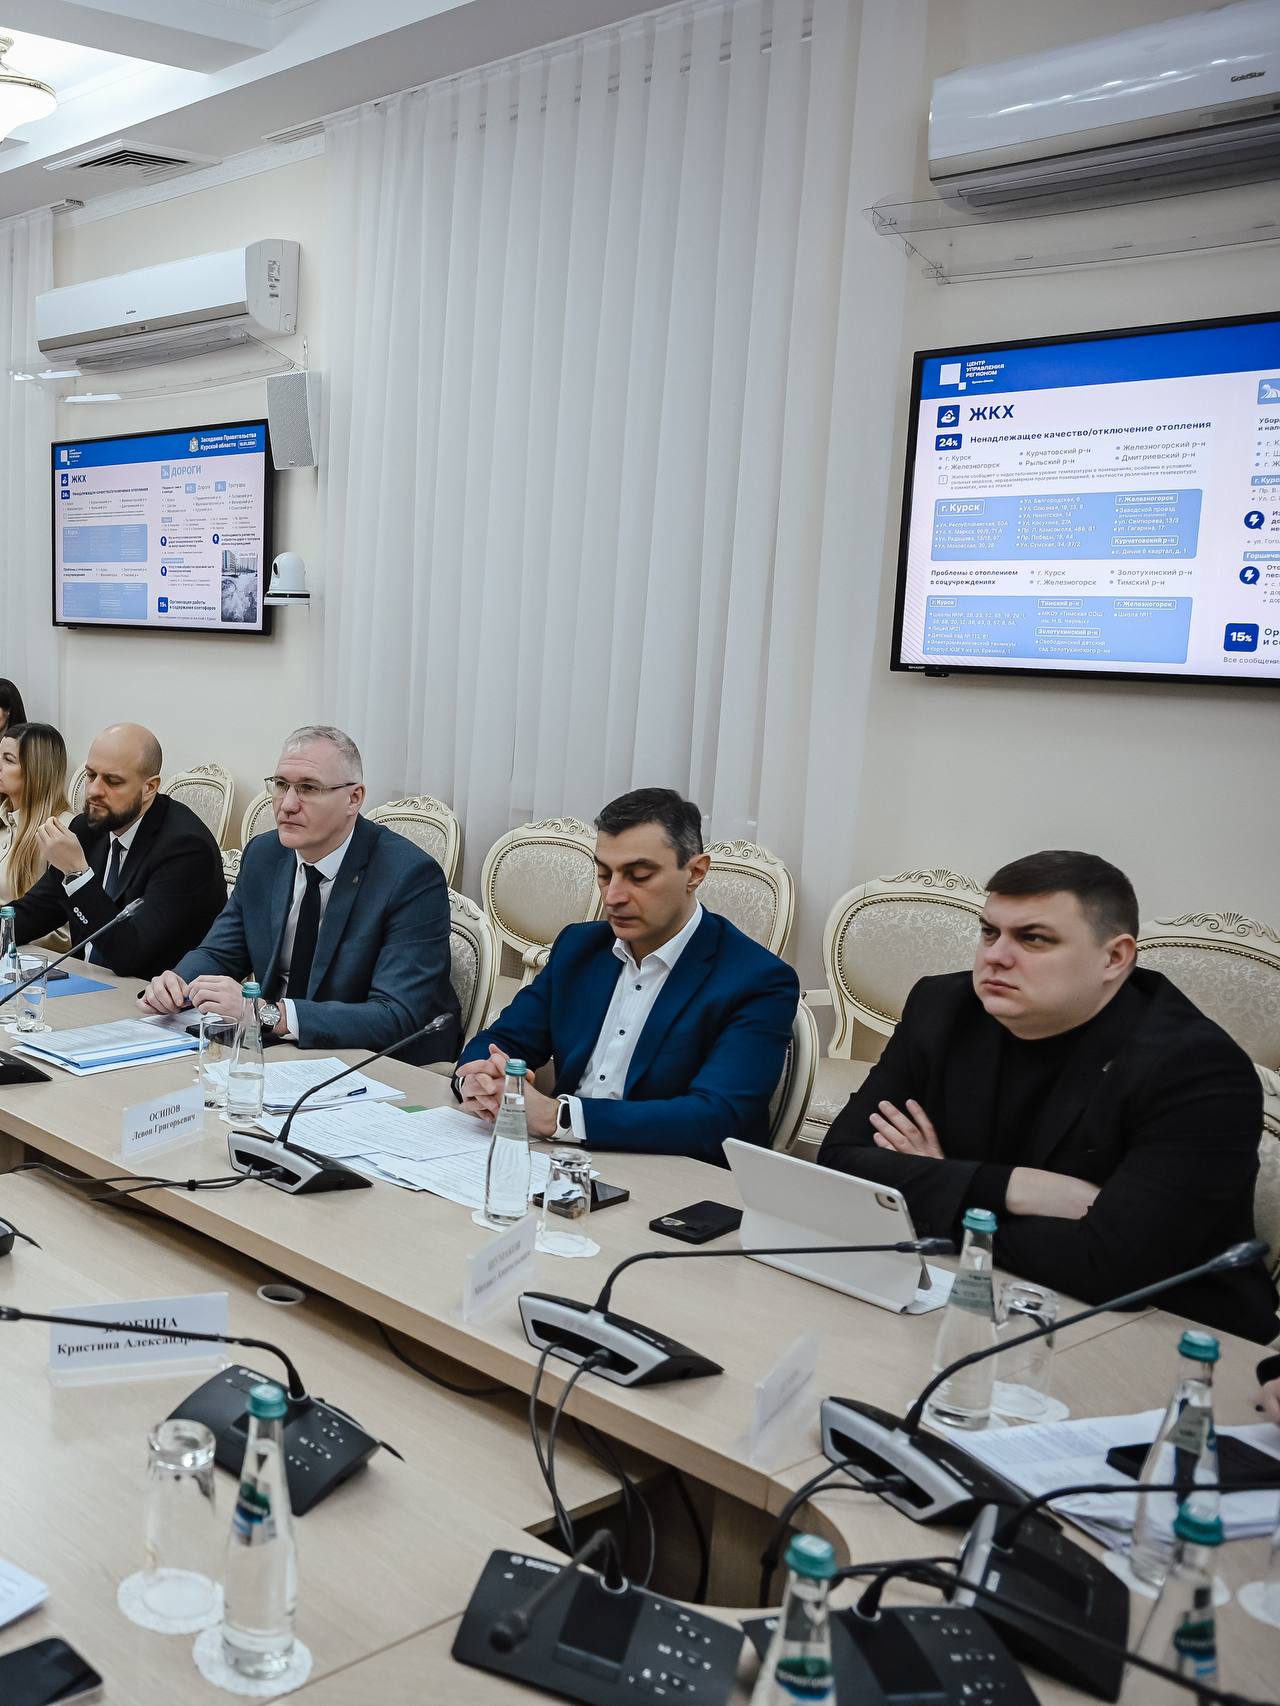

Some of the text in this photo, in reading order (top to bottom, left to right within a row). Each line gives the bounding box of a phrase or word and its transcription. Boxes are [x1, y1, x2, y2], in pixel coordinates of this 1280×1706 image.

[1230, 70, 1266, 83] GoldStar
[966, 363, 1005, 373] УПРАВЛЕНИЯ
[965, 370, 998, 378] РЕГИОНОМ
[968, 404, 1015, 422] ЖКХ
[970, 421, 1212, 443] Ненадлежащее качество/отключение отопления
[938, 437, 959, 448] 24%
[1123, 440, 1206, 451] Железногорский р-н
[1025, 446, 1091, 457] Курчатовский р-н
[1121, 451, 1196, 462] Дмитриевский р-н
[951, 454, 972, 462] Курск
[1025, 458, 1075, 467] Рыльский р-н
[171, 464, 202, 478] ДОРОГИ
[951, 462, 1001, 471] Железногорск
[71, 474, 87, 484] ЖКХ
[949, 503, 980, 513] Курск
[930, 569, 967, 577] Проблемы
[974, 569, 1018, 577] отоплением
[1044, 569, 1066, 578] Курск
[1117, 568, 1193, 577] Золотухинский р-н
[936, 579, 996, 587] соцучреждениях
[1043, 579, 1097, 587] Железногорск
[1116, 578, 1150, 586] Тимский
[1230, 631, 1253, 642] 15%
[1223, 656, 1237, 664] Все
[149, 1104, 181, 1122] ОСИПОВ
[154, 1113, 196, 1134] Григорьевич
[56, 1342, 120, 1357] Кристина
